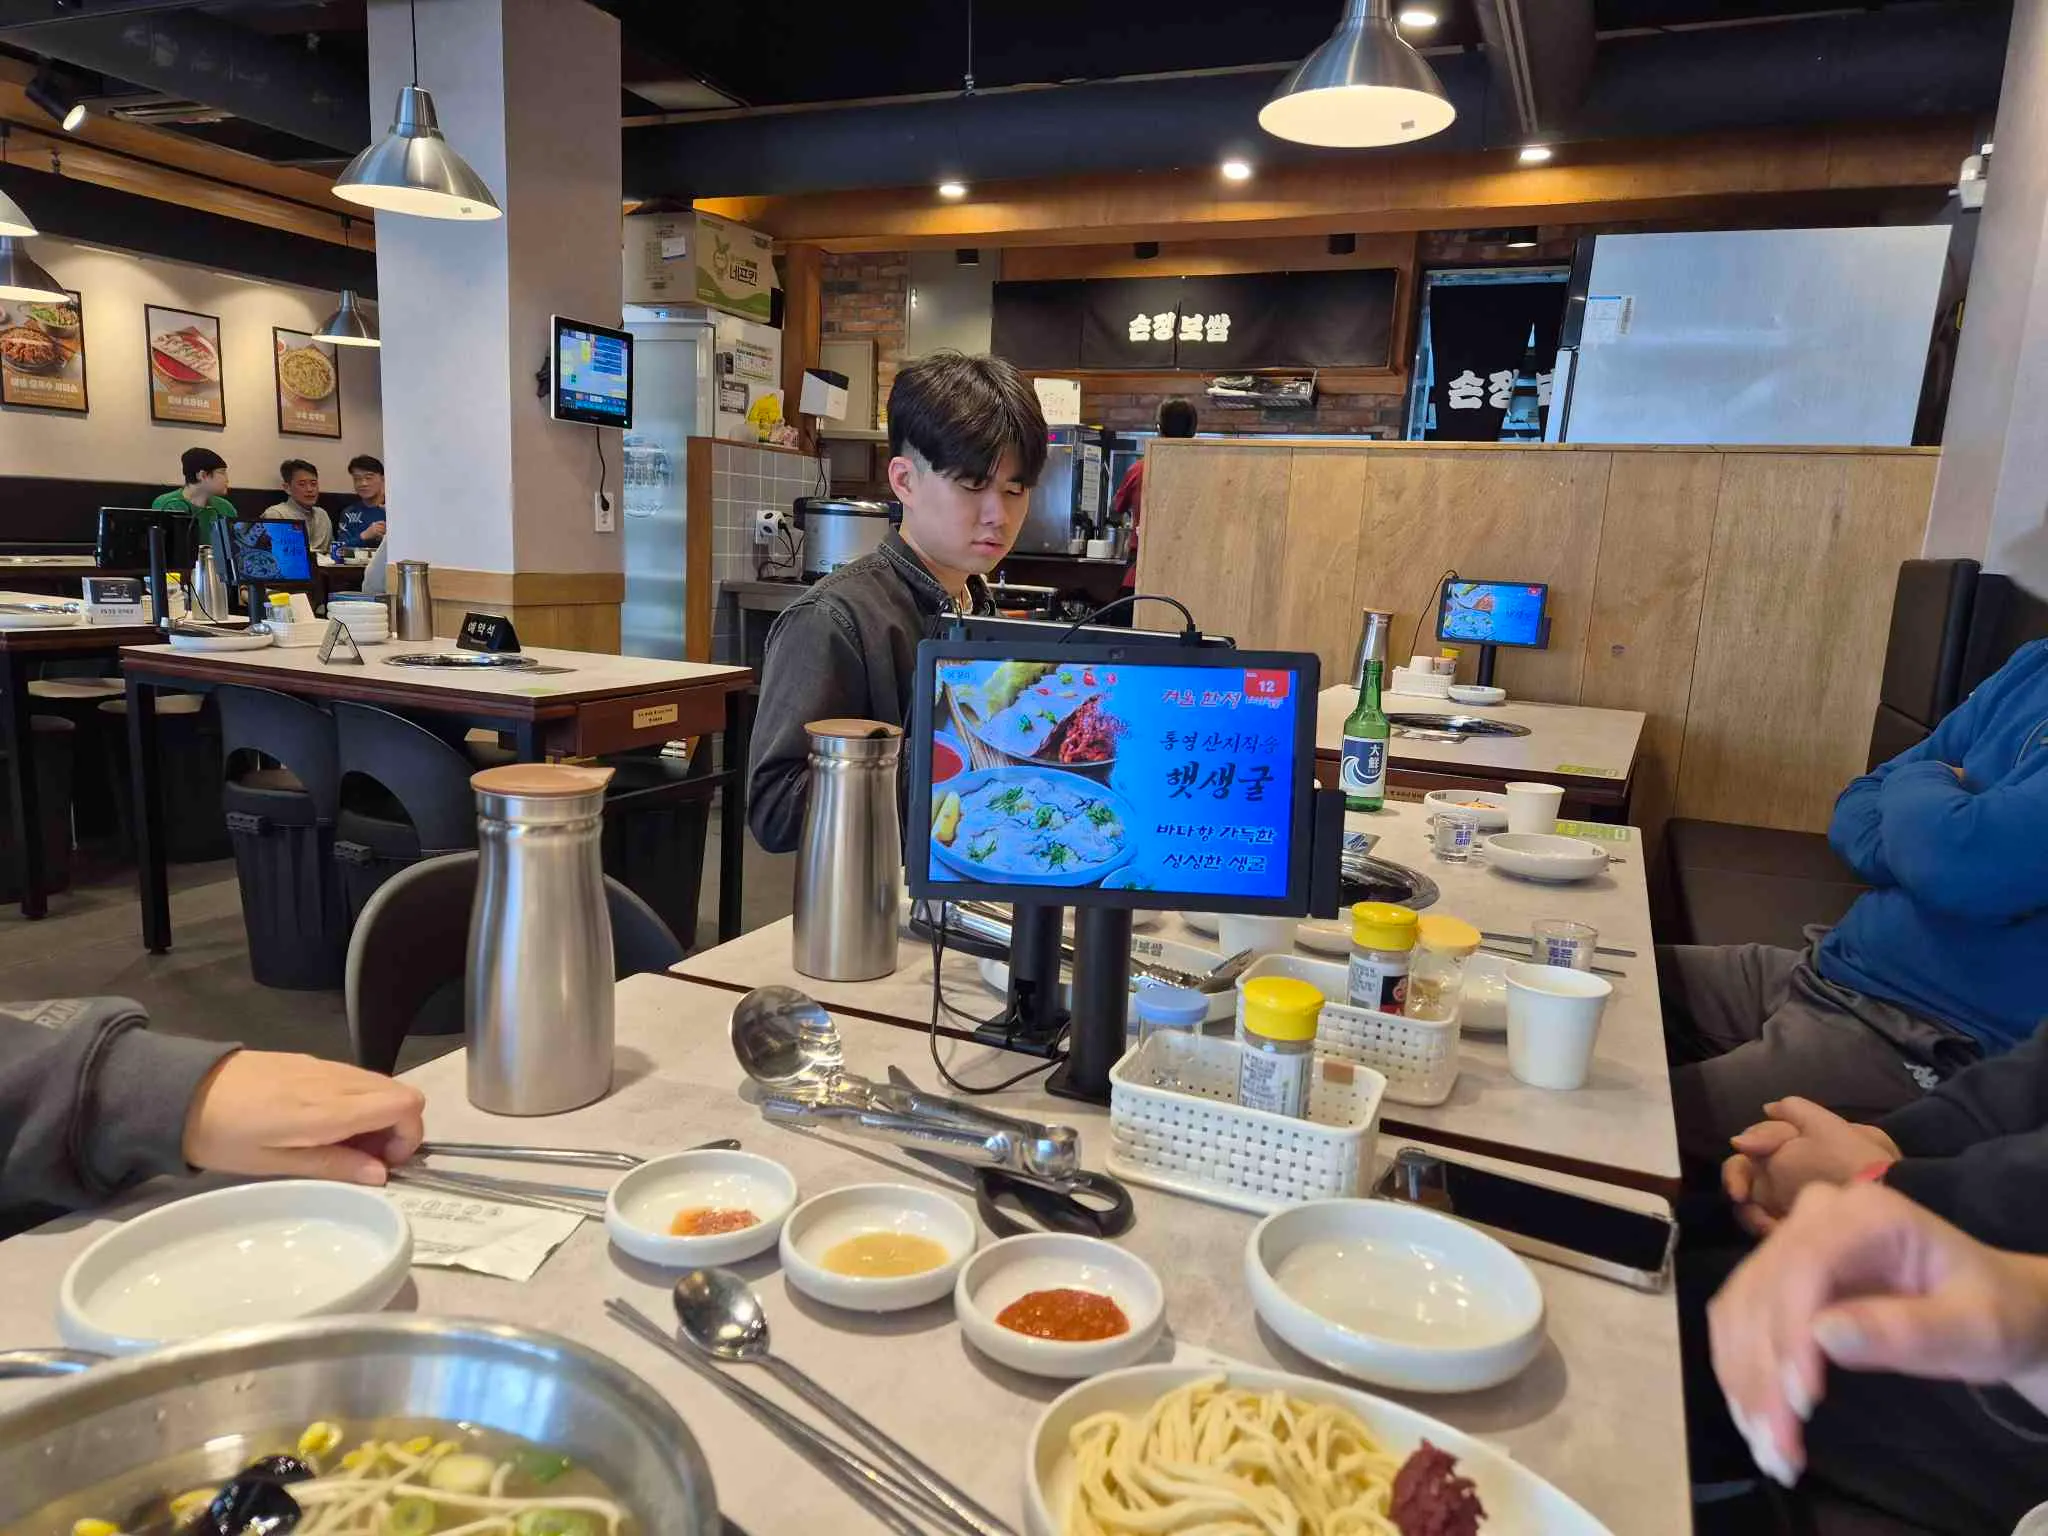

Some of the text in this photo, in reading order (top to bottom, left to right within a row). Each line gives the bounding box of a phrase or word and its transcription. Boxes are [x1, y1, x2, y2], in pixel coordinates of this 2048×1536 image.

[1128, 311, 1232, 342] 손정보쌈
[467, 621, 496, 638] 예약석
[1257, 680, 1276, 692] 12
[1200, 688, 1242, 710] 한정
[1160, 730, 1280, 754] 통영 산지직송
[1166, 760, 1275, 802] 햇생굴
[1155, 823, 1277, 845] 바다향 가득한
[1162, 852, 1222, 870] 싱싱한
